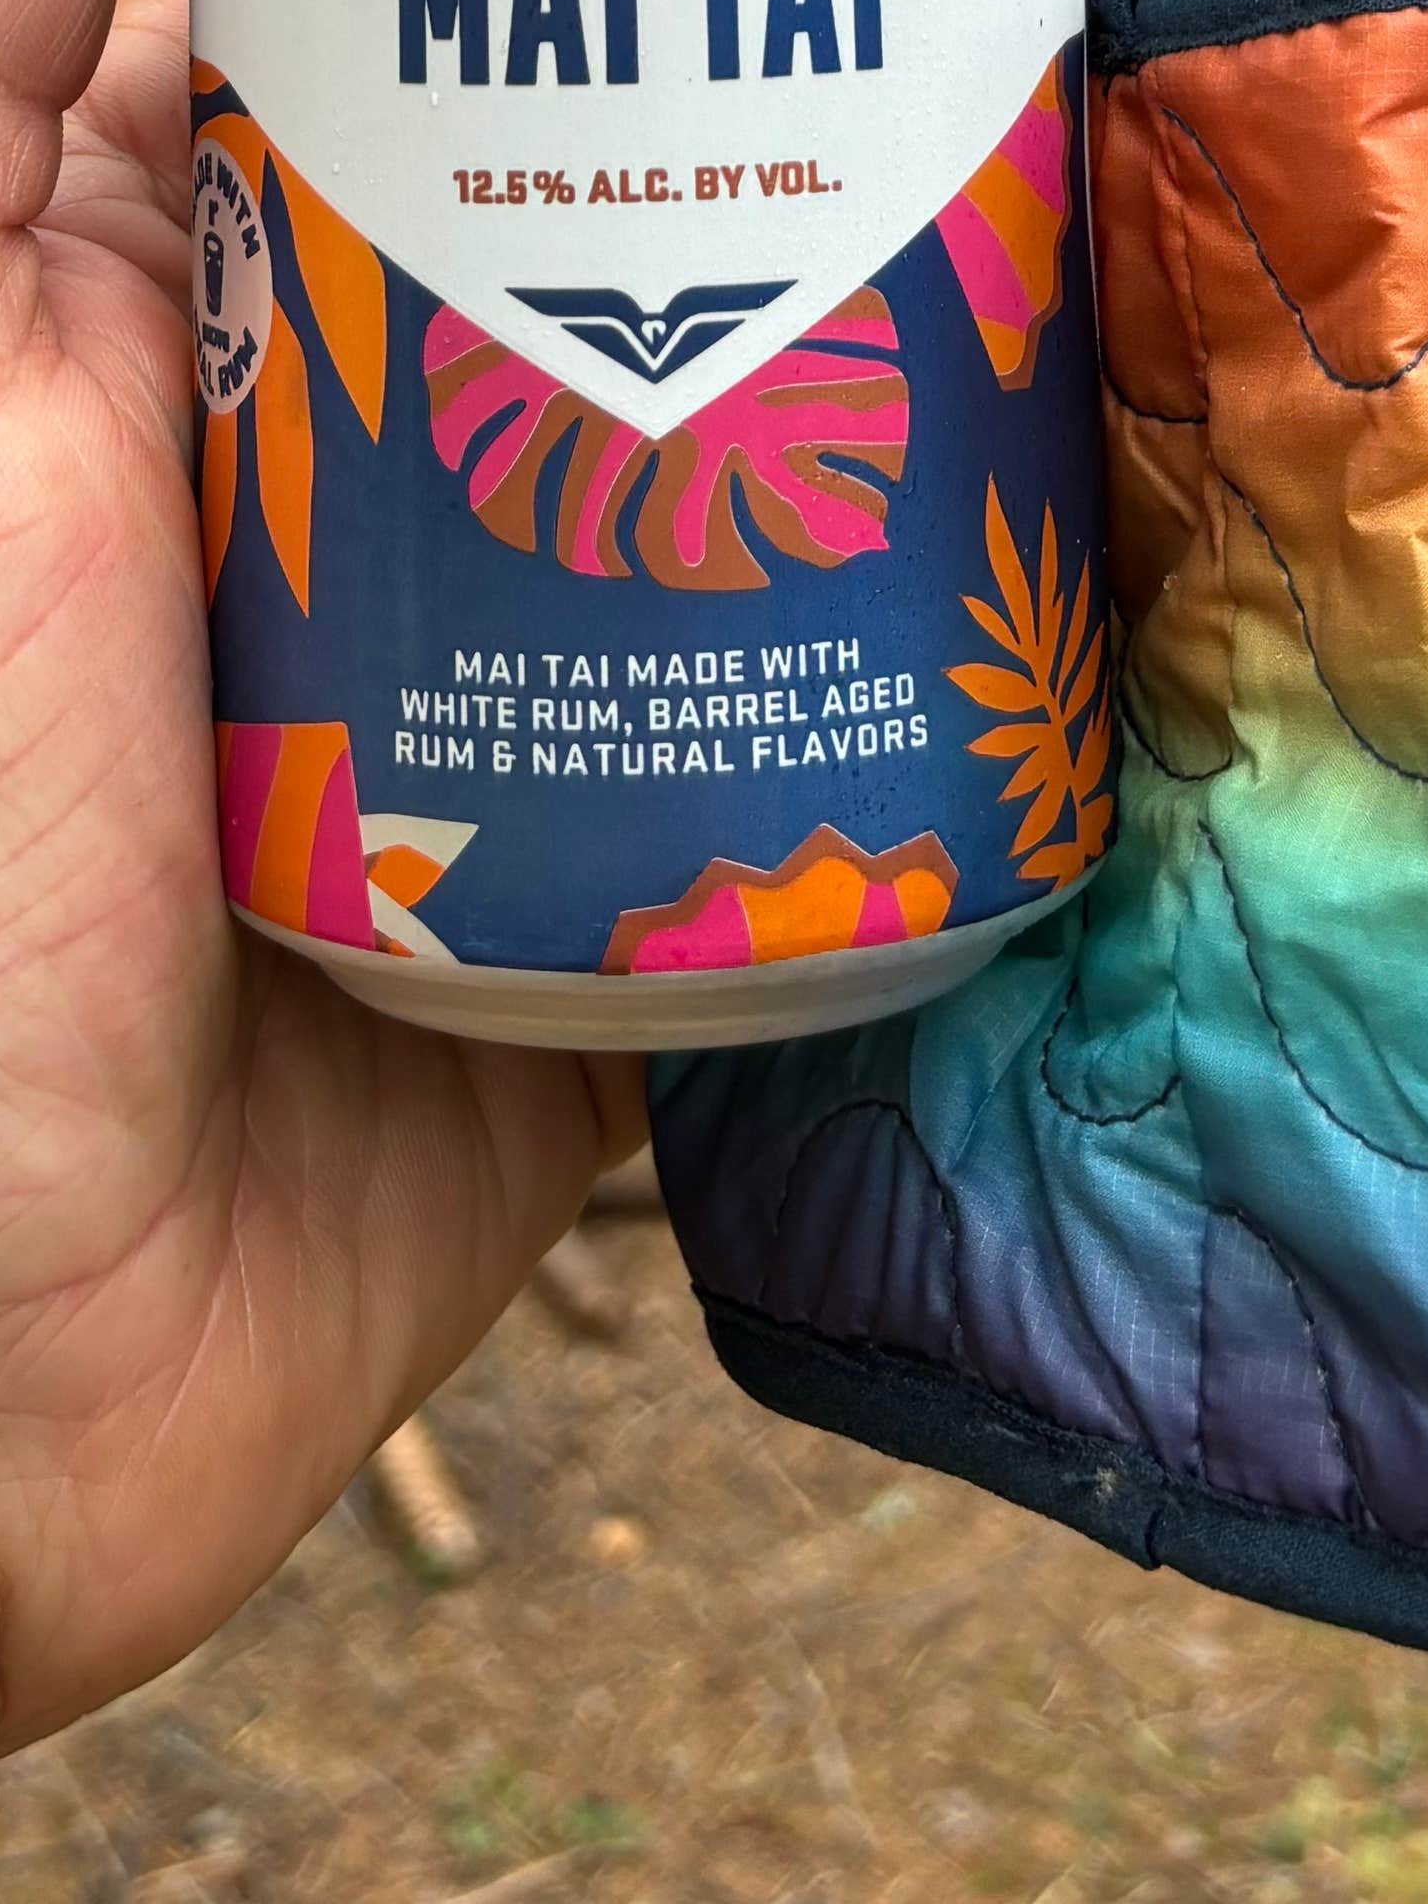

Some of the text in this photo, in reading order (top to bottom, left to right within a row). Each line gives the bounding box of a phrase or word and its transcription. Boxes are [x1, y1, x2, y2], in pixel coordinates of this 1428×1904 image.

[216, 155, 261, 260] WITH
[453, 160, 843, 205] 12.5% ALC. BY VOL.
[217, 325, 258, 399] RUM
[455, 637, 860, 688] MAI TAI MADE WITH
[400, 672, 915, 738] WHITE RUM, BARREL AGED
[395, 713, 928, 776] RUM & NATURAL FLAVORS
